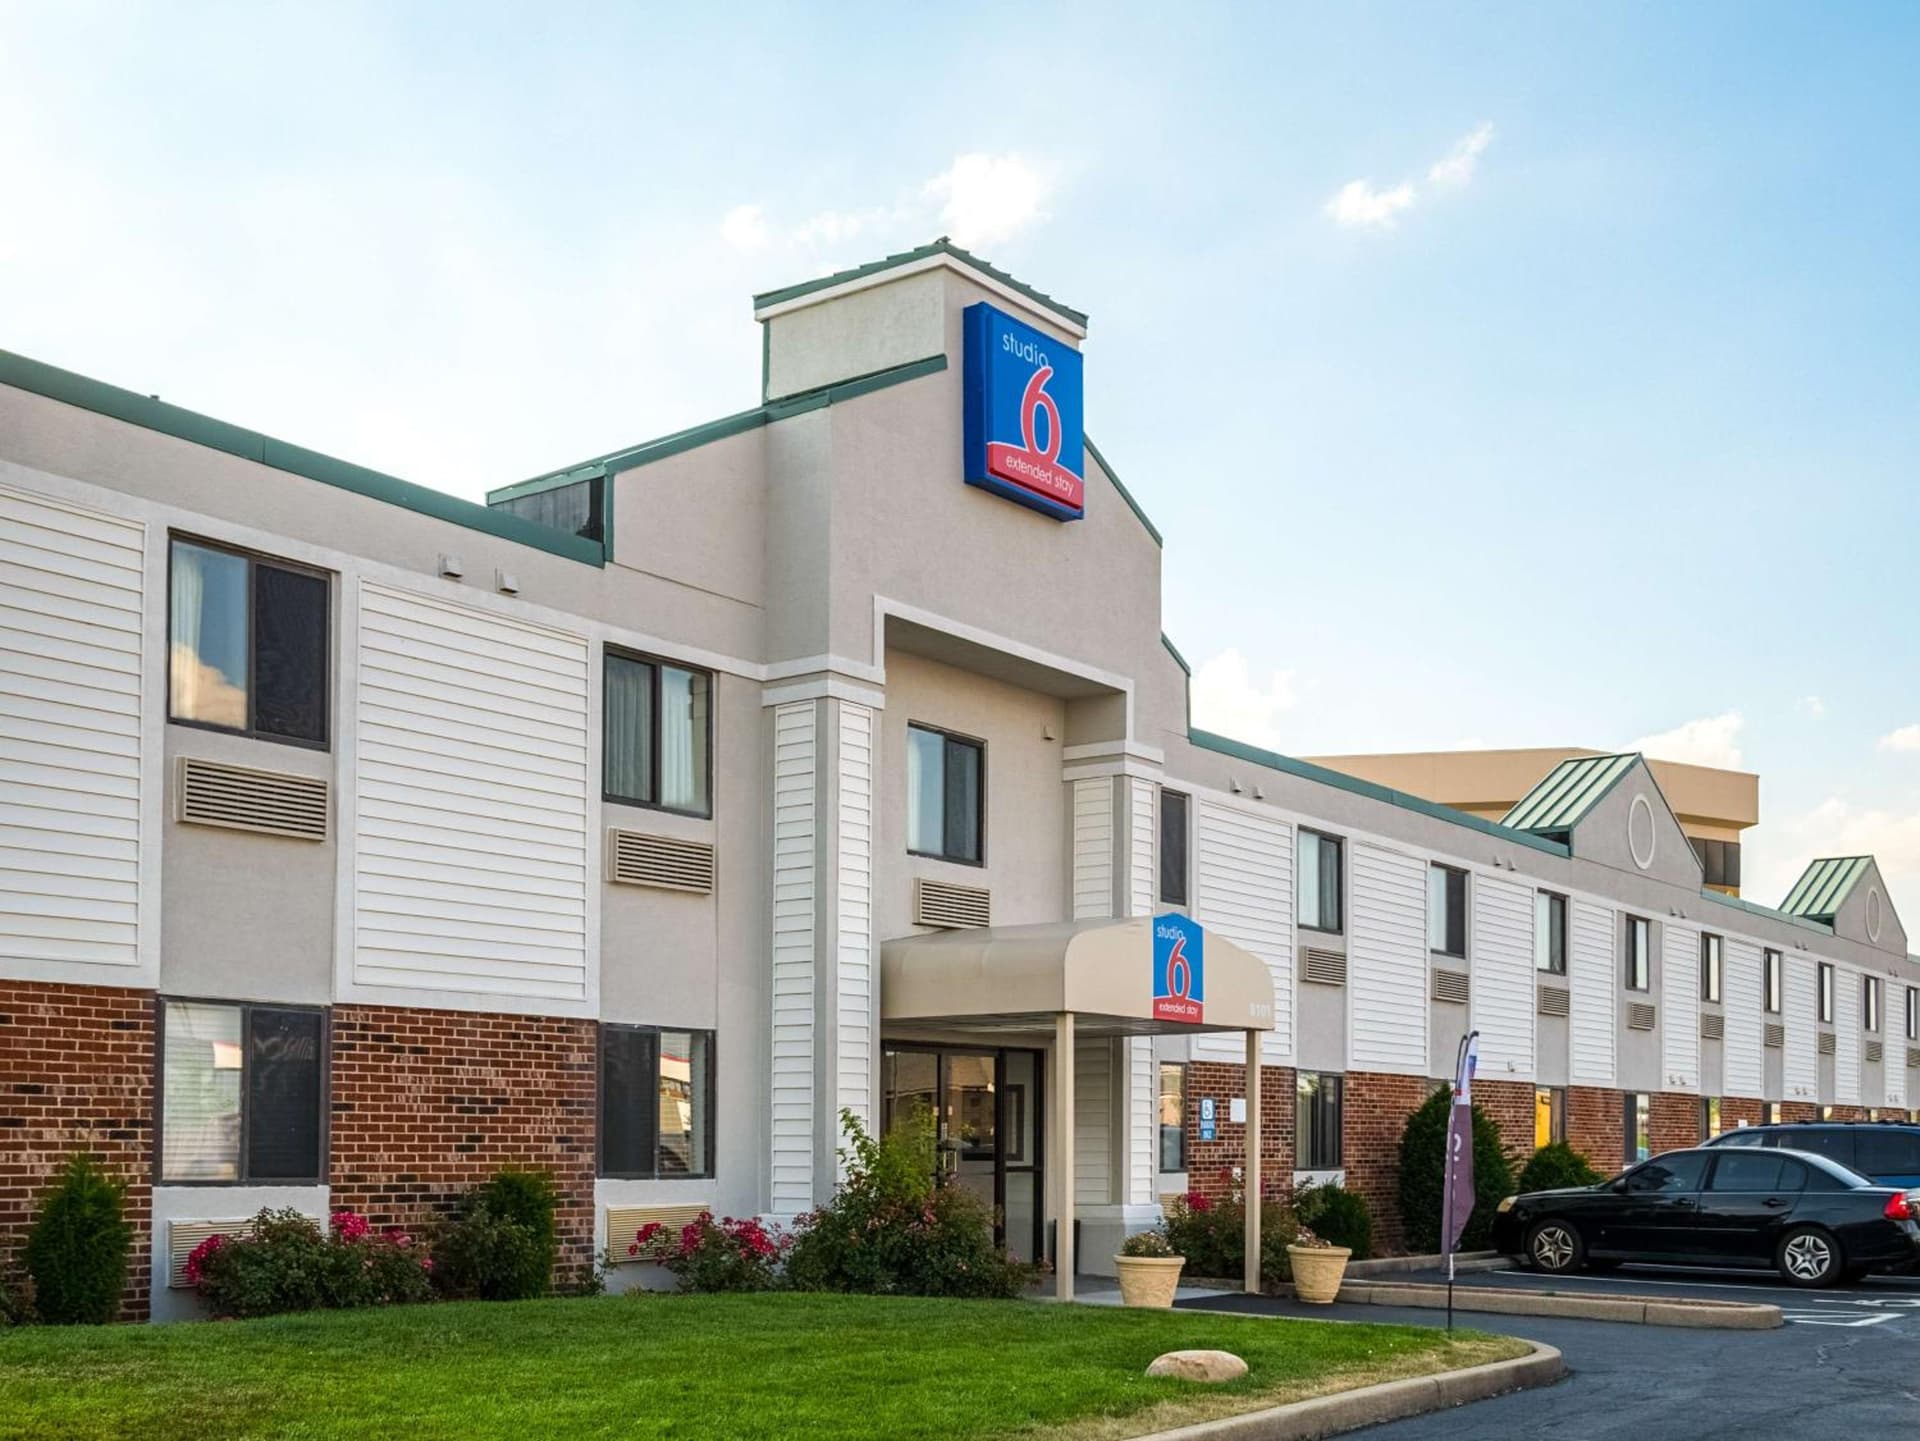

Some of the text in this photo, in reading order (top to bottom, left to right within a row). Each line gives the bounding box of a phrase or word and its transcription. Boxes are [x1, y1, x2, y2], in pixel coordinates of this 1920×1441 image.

[1002, 333, 1049, 368] studio
[1020, 365, 1063, 459] 6
[1006, 454, 1075, 497] extended stay
[1157, 924, 1184, 939] studio
[1167, 937, 1192, 998] 6
